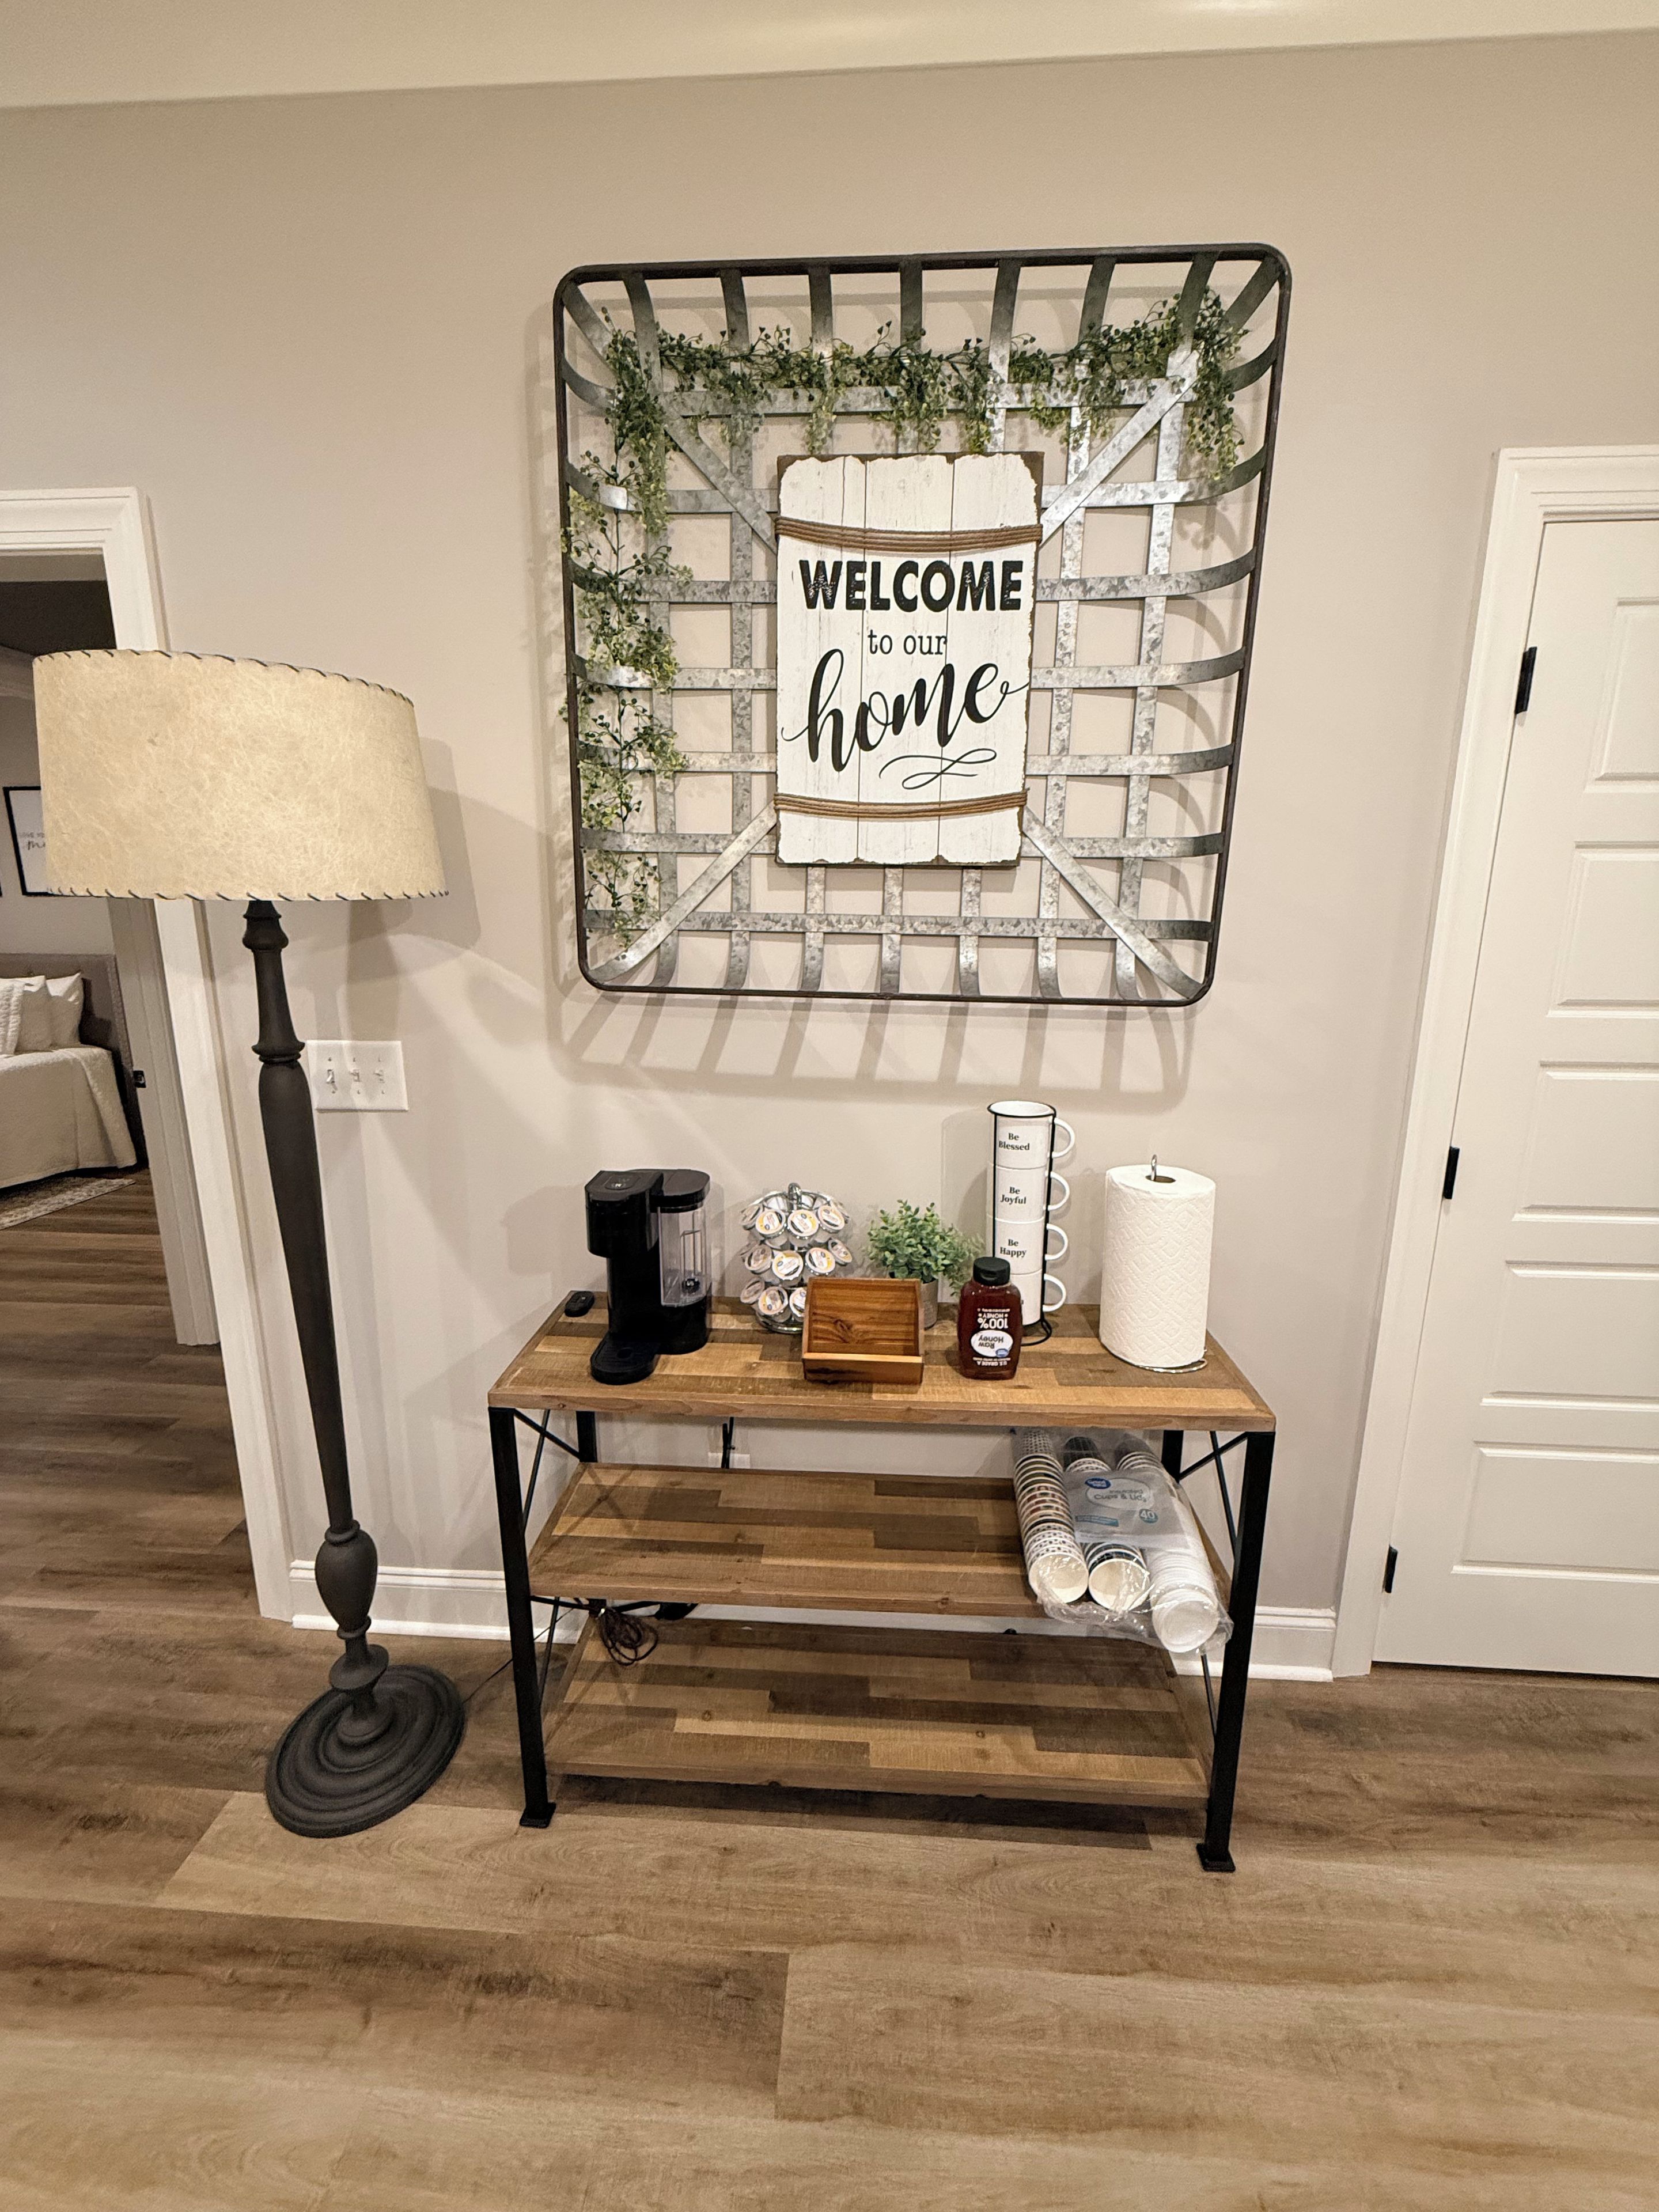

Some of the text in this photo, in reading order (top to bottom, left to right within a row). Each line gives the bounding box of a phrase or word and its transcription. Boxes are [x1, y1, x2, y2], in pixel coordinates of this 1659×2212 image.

[799, 560, 1023, 612] WELCOME
[868, 630, 948, 655] to our
[782, 649, 1029, 772] home
[1008, 1132, 1020, 1141] Be
[998, 1141, 1030, 1151] Blessed
[1009, 1187, 1020, 1195] Be
[1000, 1194, 1027, 1205] Joyful
[999, 1247, 1027, 1257] Happy
[978, 1318, 1008, 1328] 100%
[1140, 1510, 1155, 1519] 40
